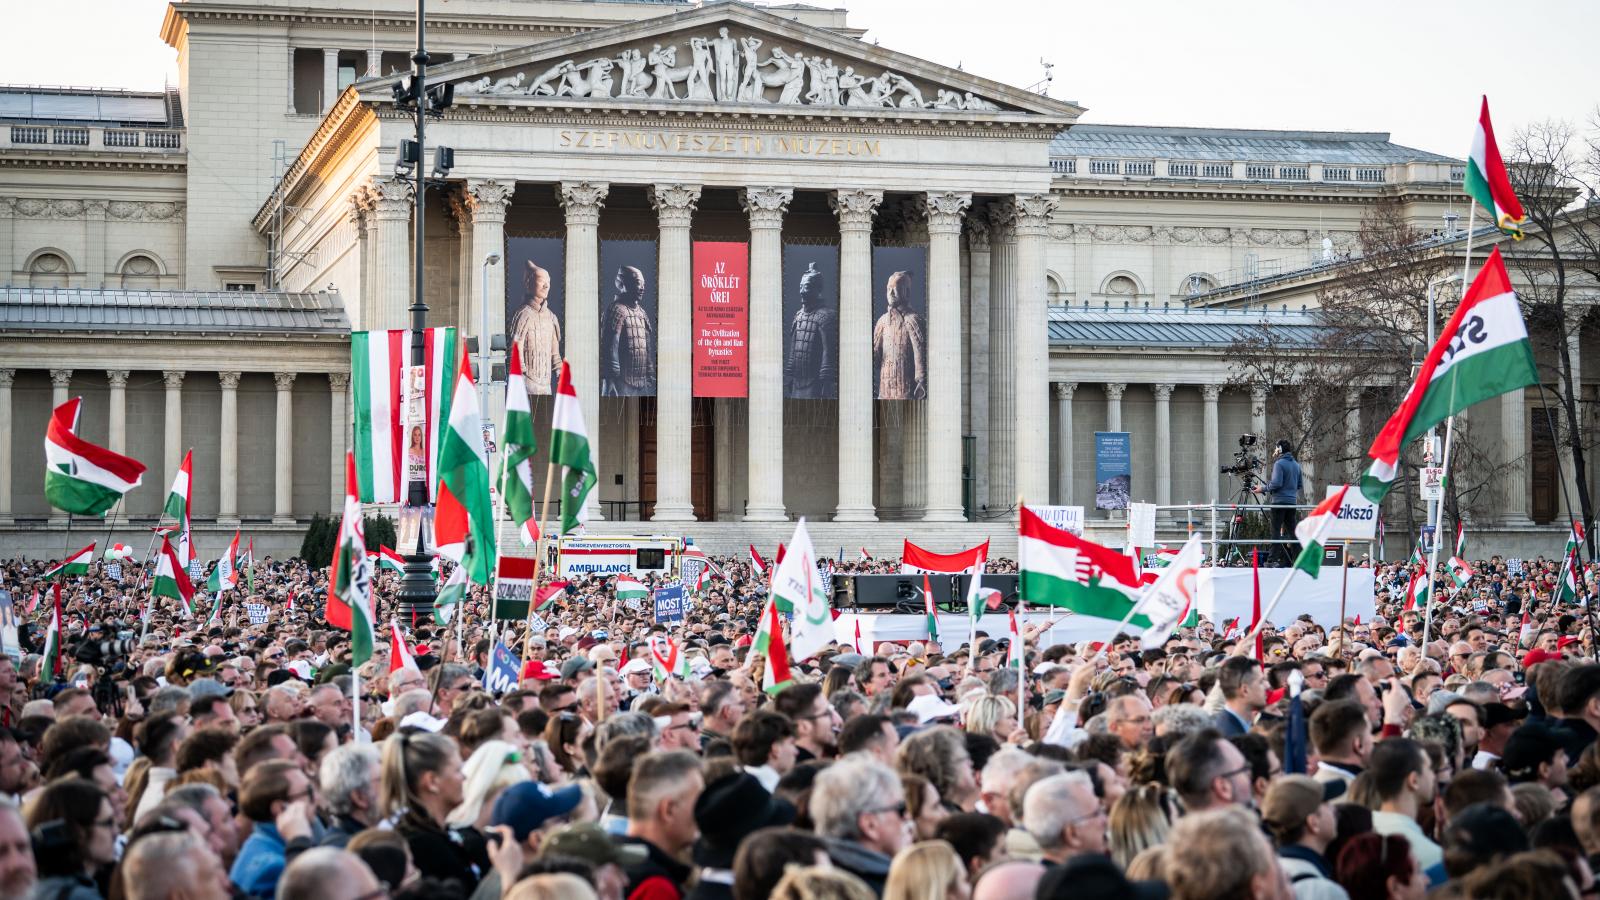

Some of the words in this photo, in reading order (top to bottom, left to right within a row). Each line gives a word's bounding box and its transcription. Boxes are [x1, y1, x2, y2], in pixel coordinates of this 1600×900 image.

[714, 261, 725, 274] AZ
[701, 274, 740, 289] ÖRÖKLÉT
[710, 288, 730, 303] ŐREI
[701, 329, 711, 337] The
[711, 329, 740, 337] Civilization
[697, 338, 703, 346] of
[708, 348, 733, 357] Dynasties
[1337, 504, 1373, 520] zikszó
[568, 564, 631, 573] AMBULANCE
[657, 598, 680, 610] MOST
